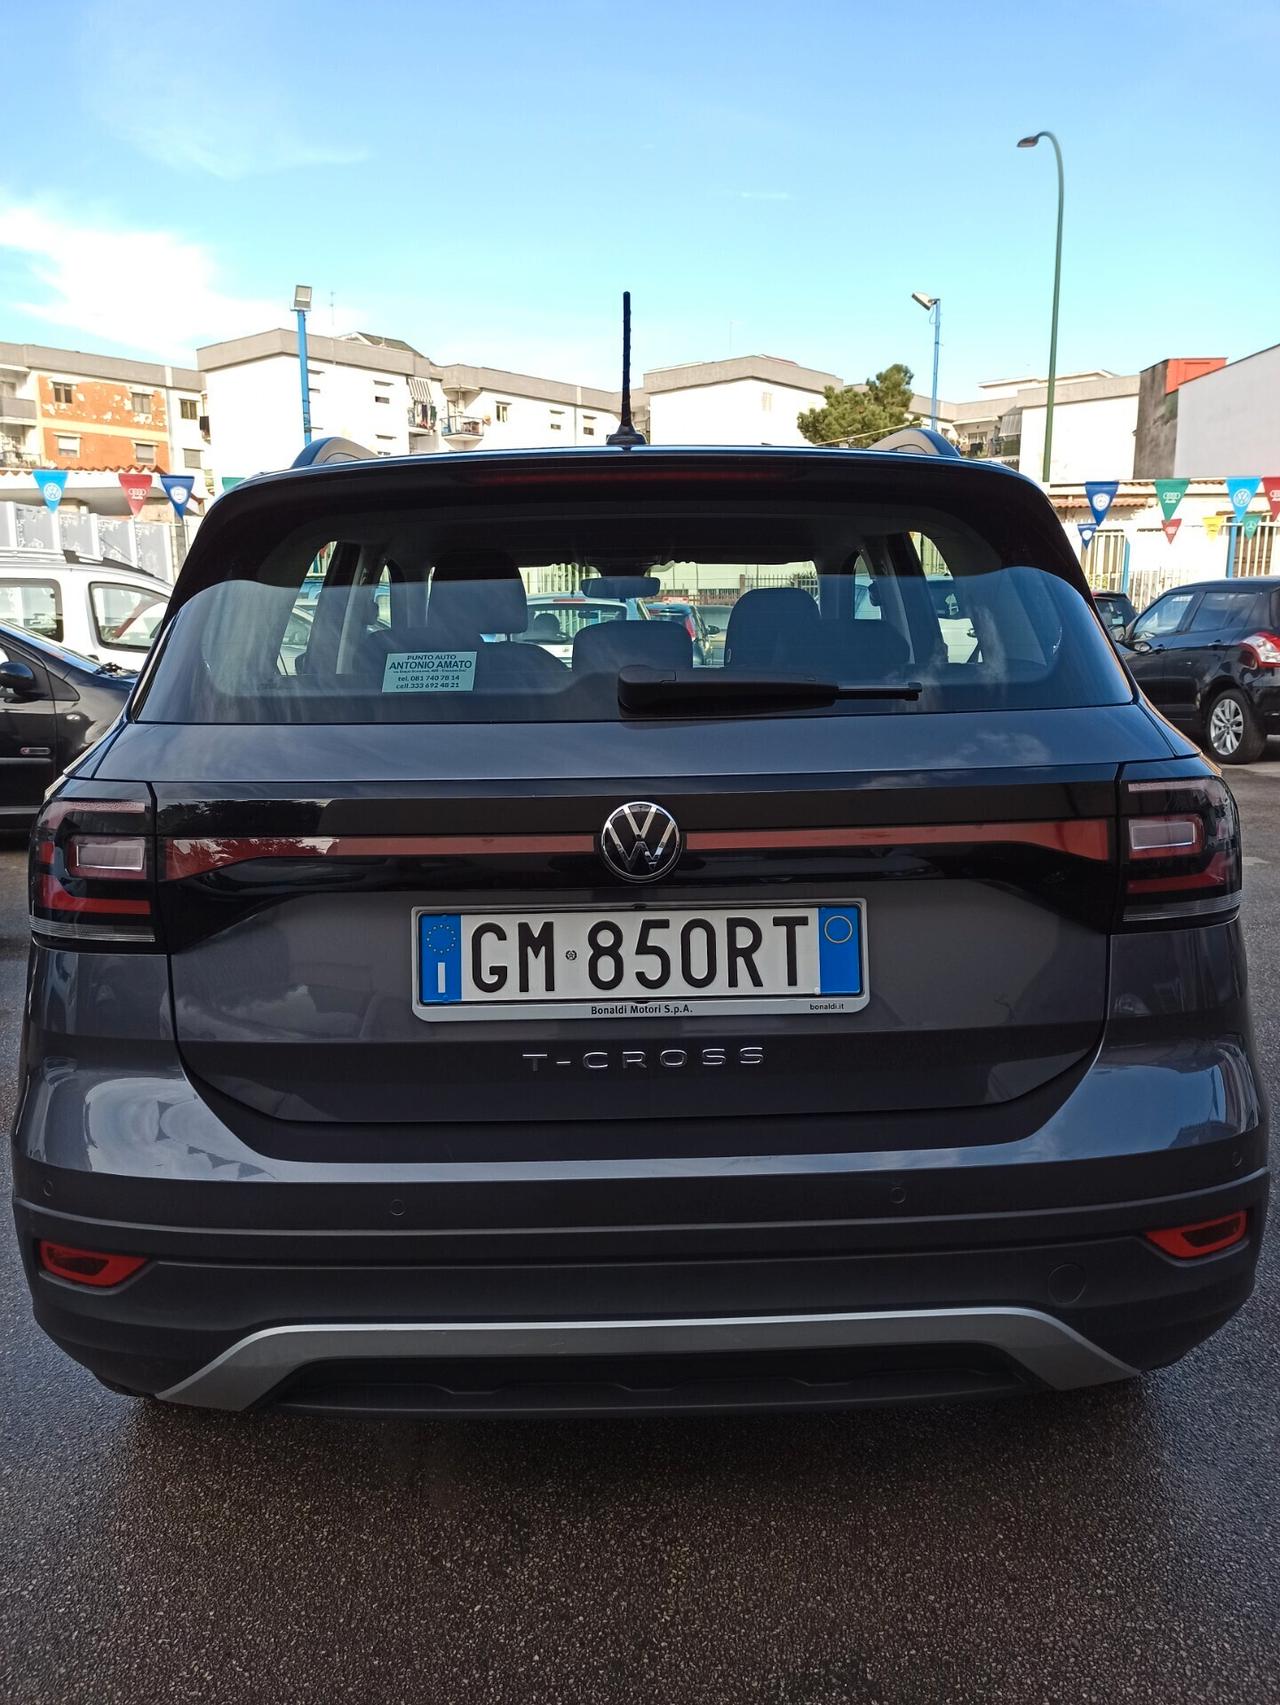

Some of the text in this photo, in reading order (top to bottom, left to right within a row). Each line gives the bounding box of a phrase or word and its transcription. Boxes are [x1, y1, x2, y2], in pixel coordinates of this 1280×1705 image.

[388, 660, 473, 670] ANTONIO AMATO
[471, 915, 809, 993] GM 850RT
[591, 1004, 693, 1016] Bonaldi Motori S.p.A.
[809, 1003, 845, 1011] bonaldi.it
[522, 1047, 764, 1072] T-CROSS
